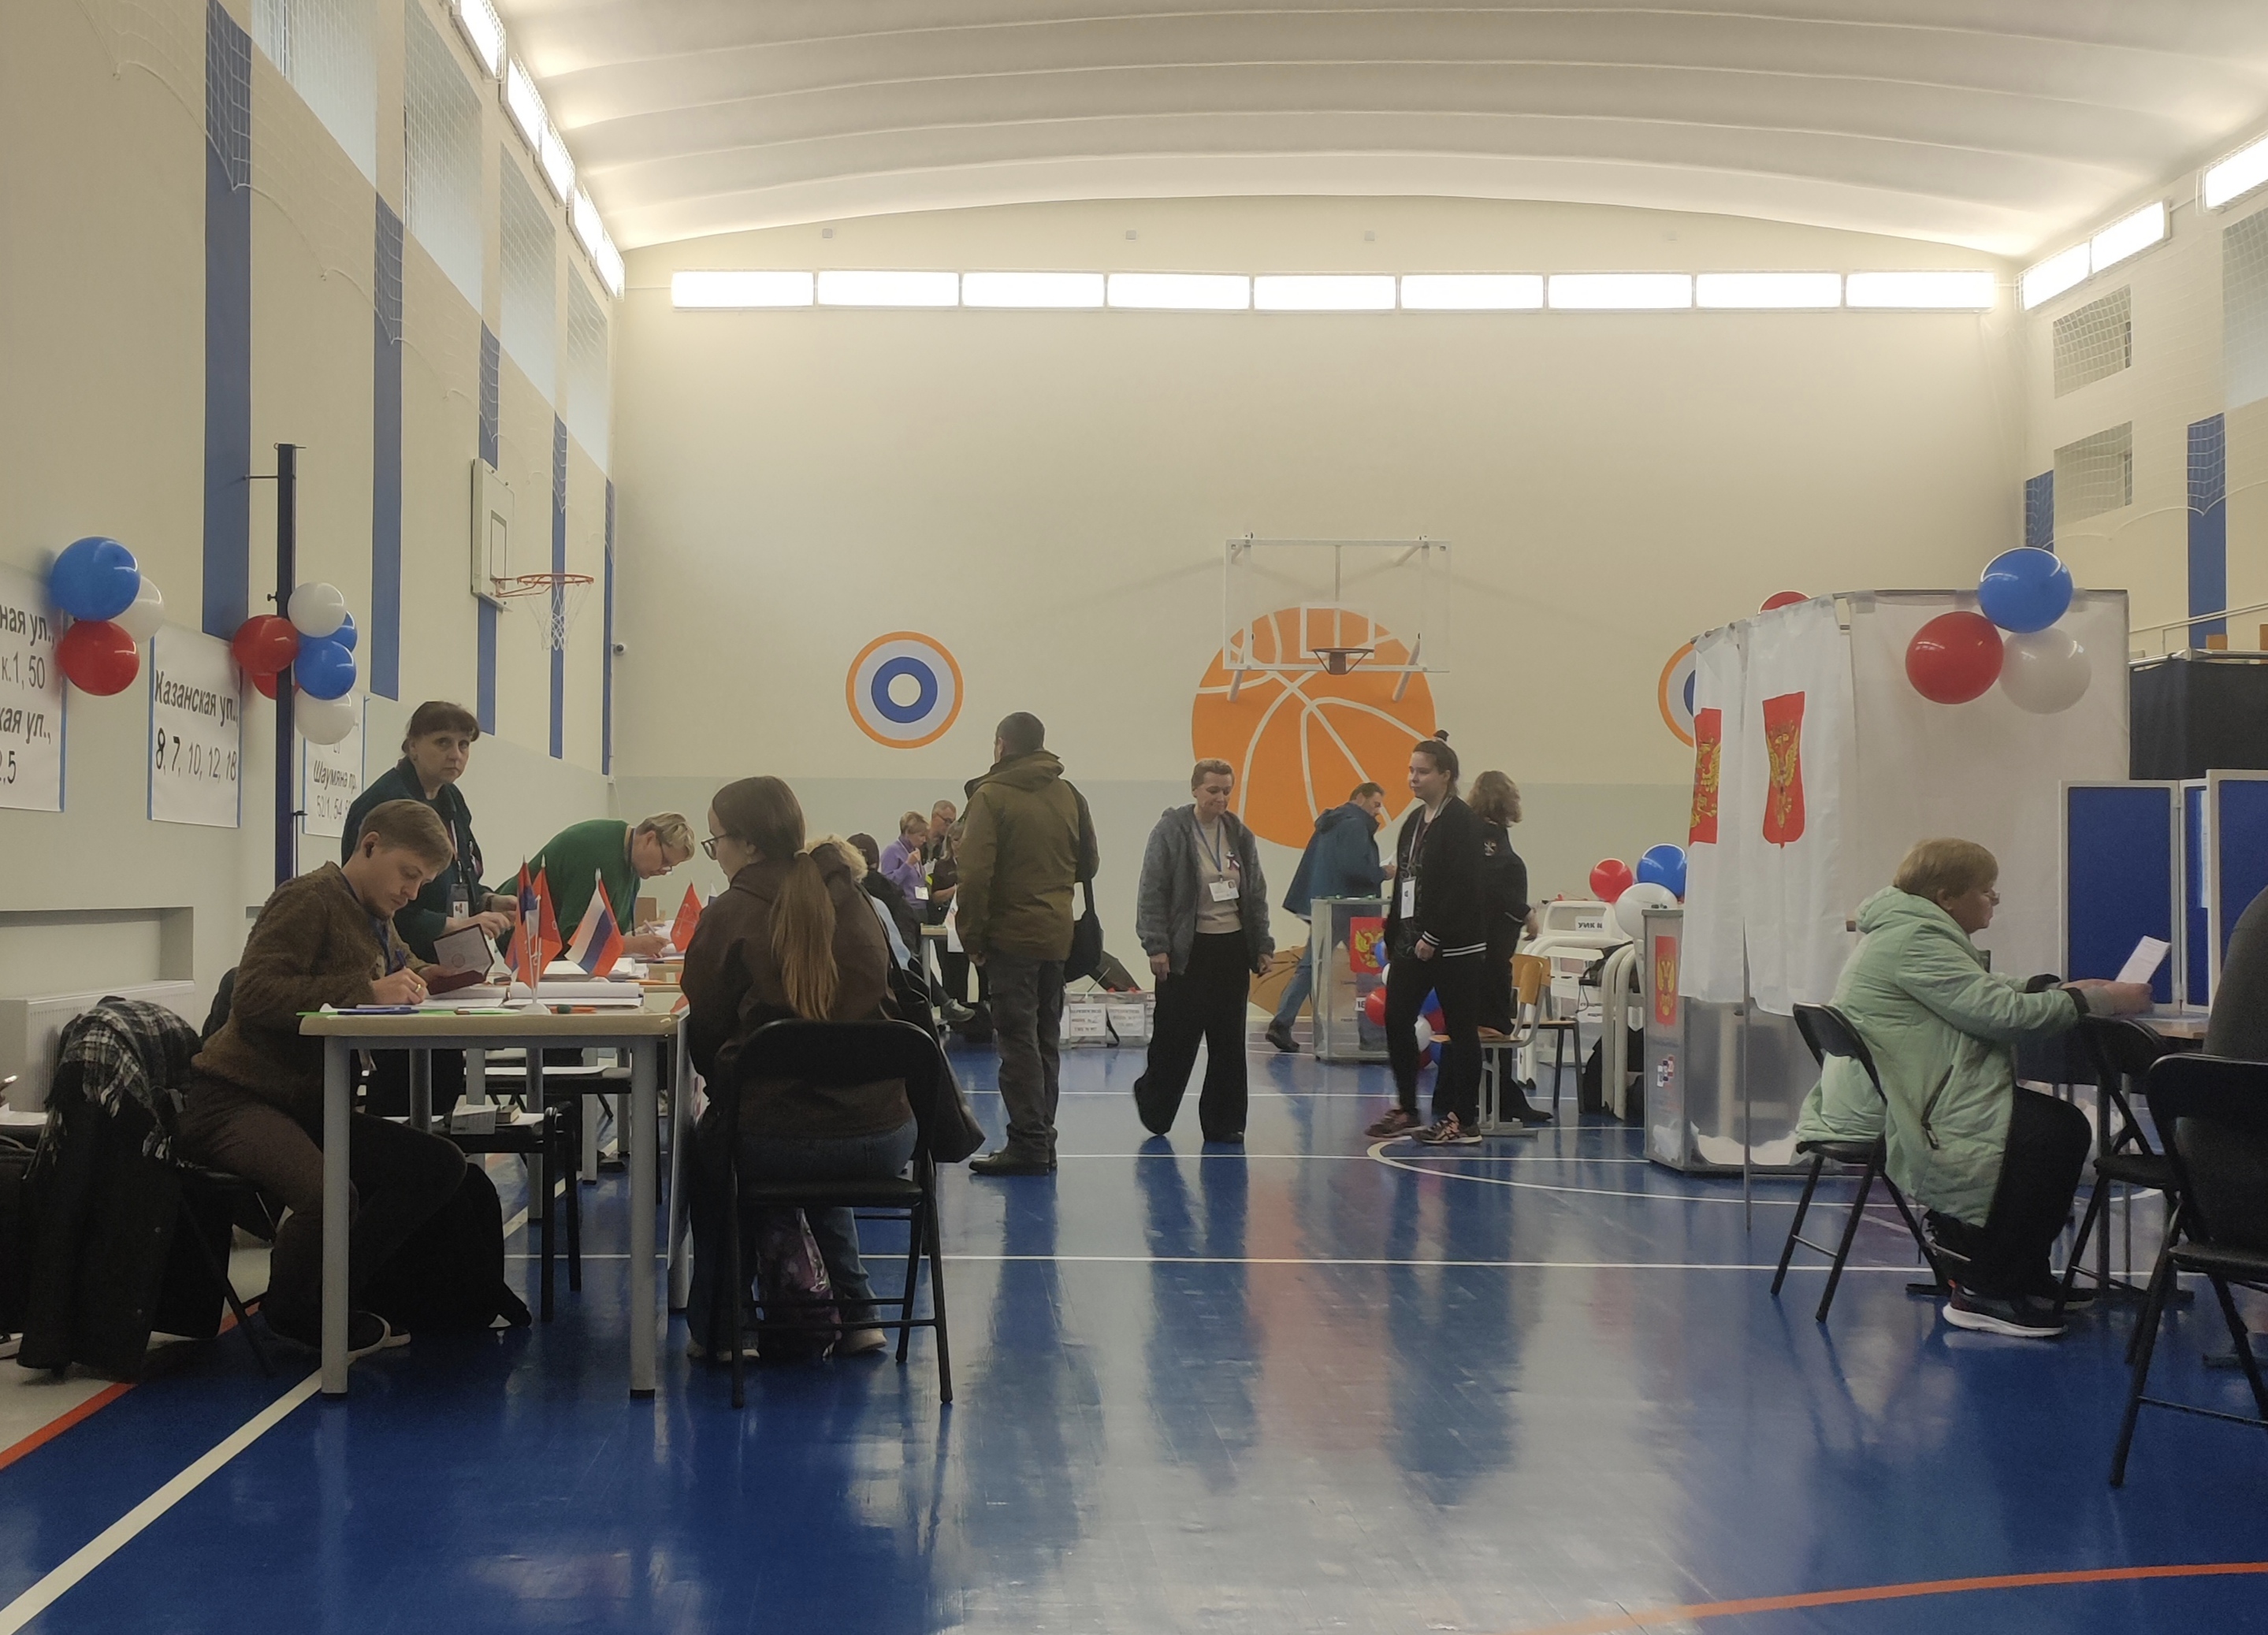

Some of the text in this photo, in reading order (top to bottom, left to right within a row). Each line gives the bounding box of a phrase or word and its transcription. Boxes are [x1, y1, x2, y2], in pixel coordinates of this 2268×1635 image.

[28, 655, 45, 689] 50
[154, 669, 216, 717] Казанская
[25, 712, 51, 745] ул.,
[156, 727, 237, 784] 8, 7, 10, 12, 18
[314, 760, 348, 790] Шаумяна
